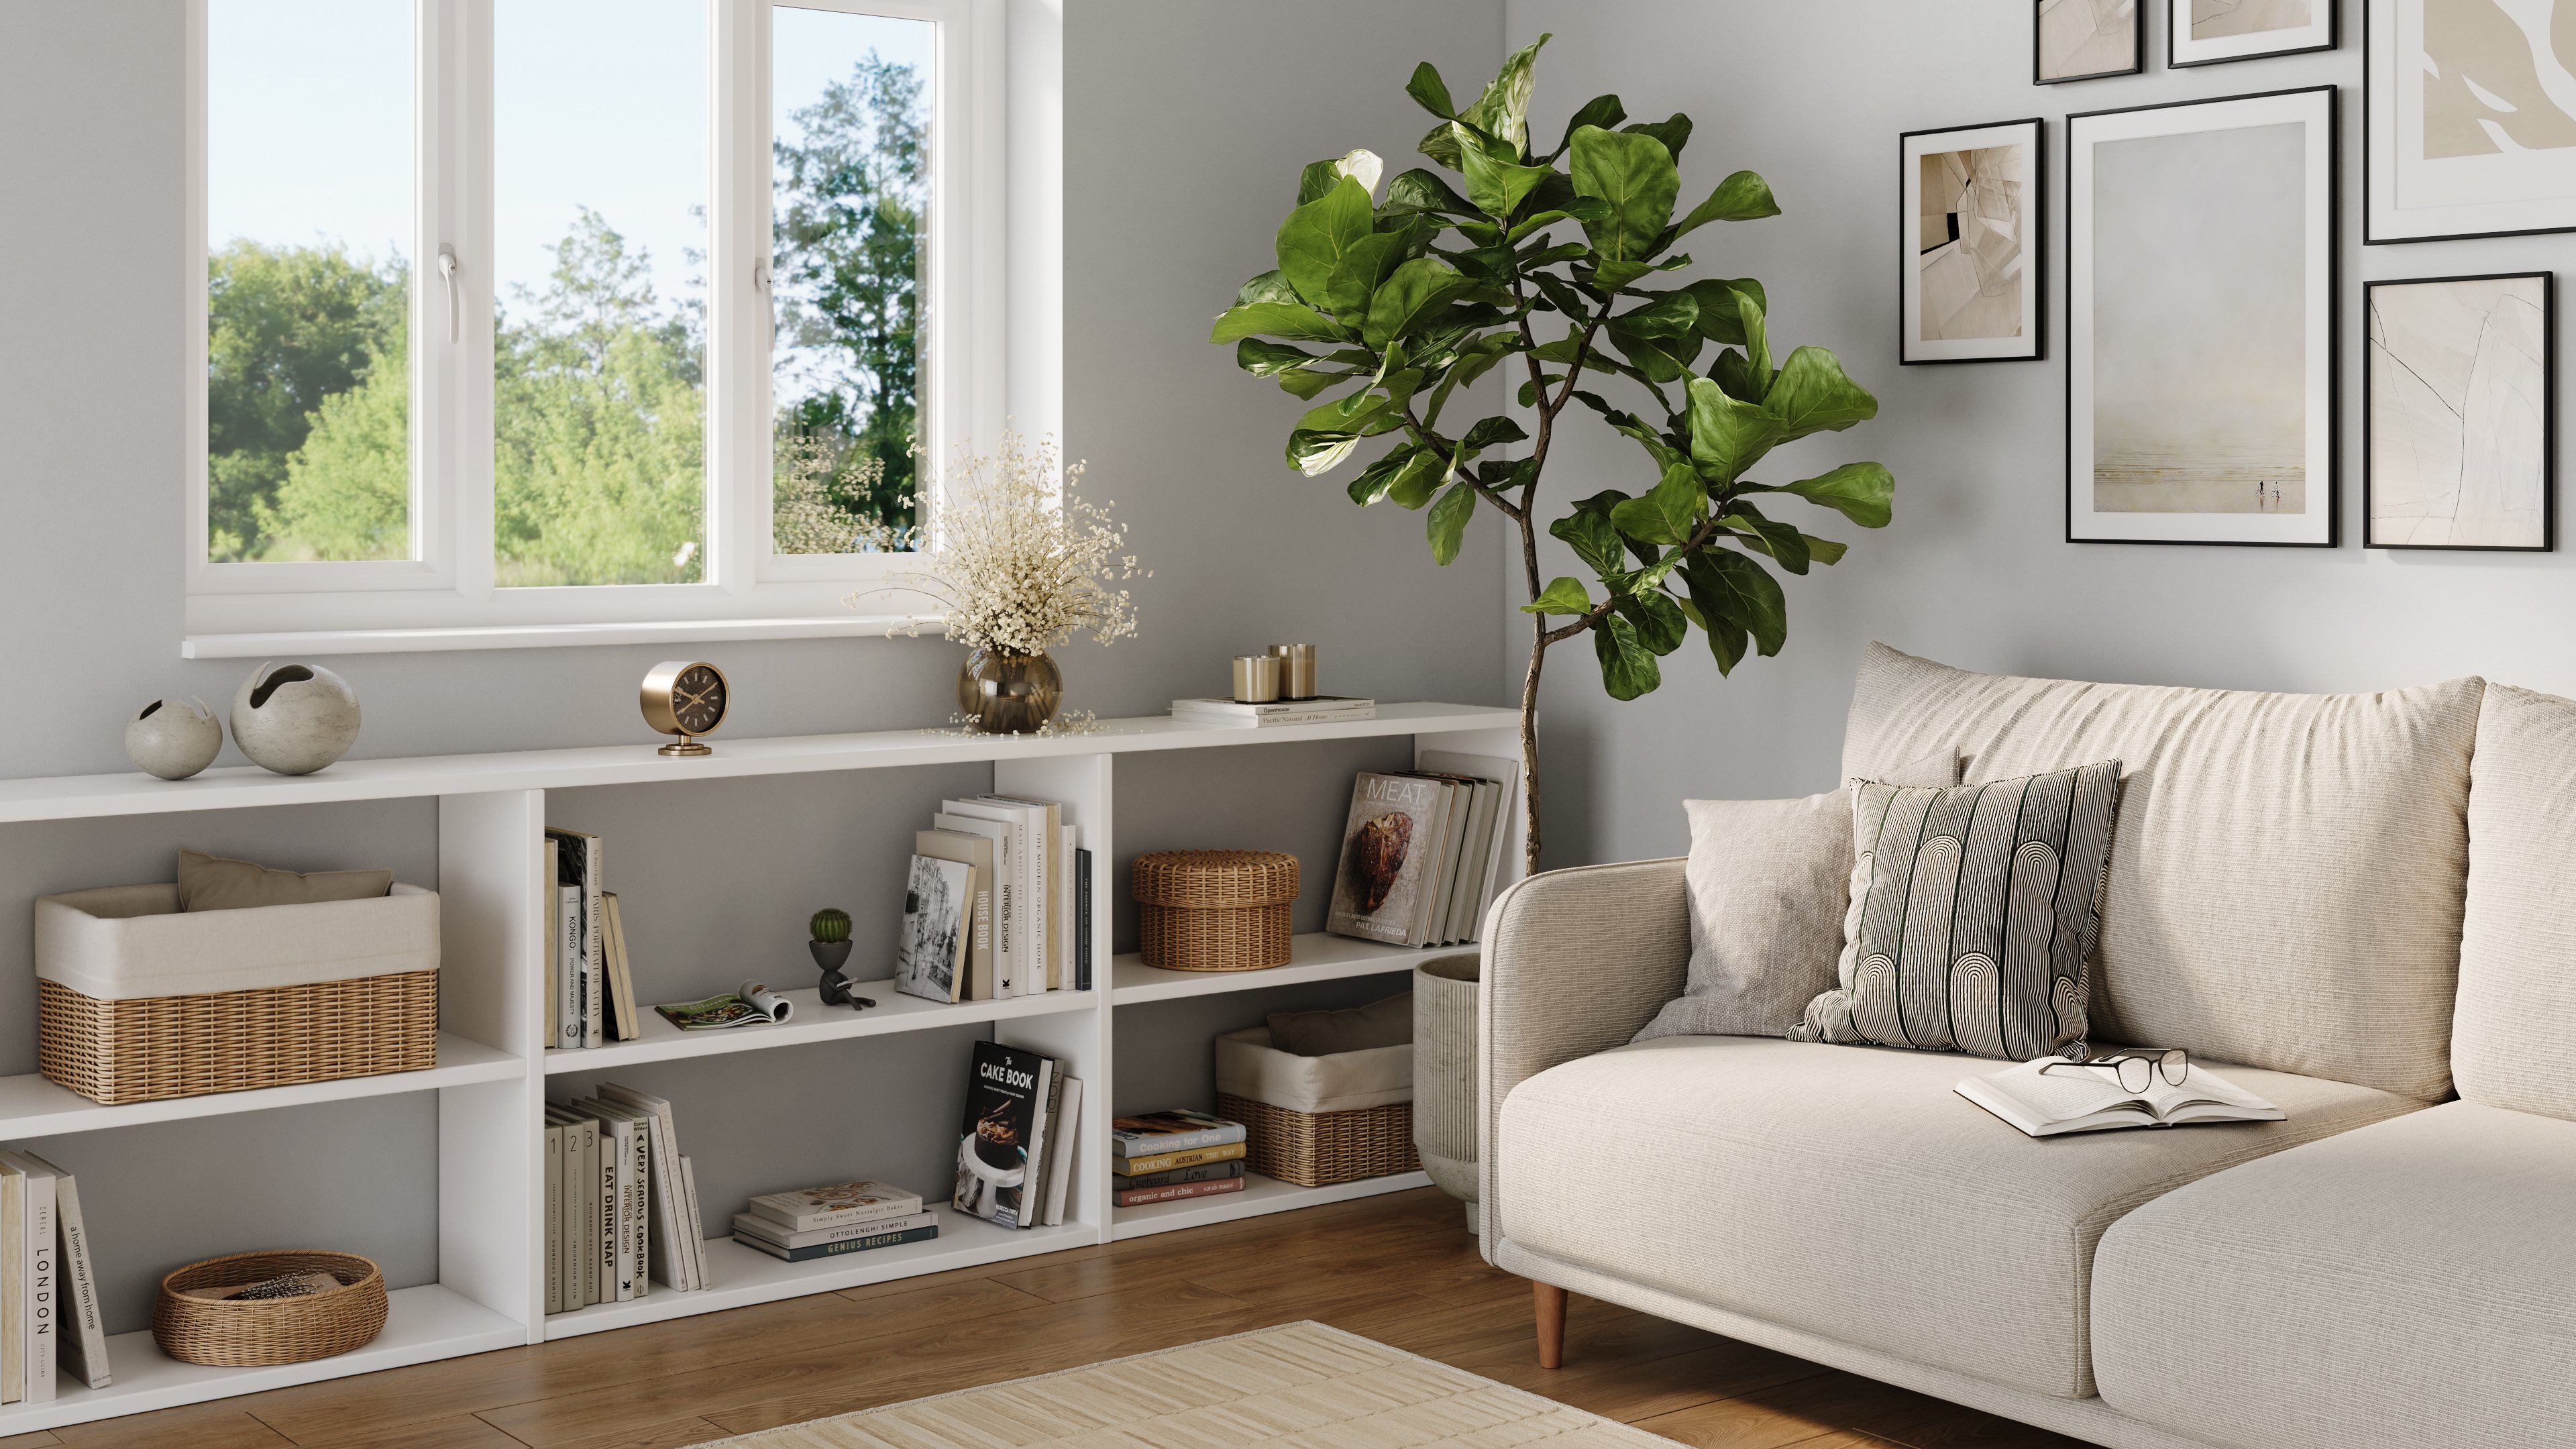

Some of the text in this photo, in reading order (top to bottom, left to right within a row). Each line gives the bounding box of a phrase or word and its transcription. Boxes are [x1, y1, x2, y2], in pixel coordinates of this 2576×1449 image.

[1367, 777, 1426, 805] MEAT
[977, 890, 989, 951] HOUSE BOOK
[1356, 921, 1407, 937] PAT LAFRIEDA
[593, 973, 600, 985] OF
[980, 1062, 1033, 1090] CAKE BOOK
[551, 1138, 555, 1154] 1
[570, 1135, 577, 1152] 2
[586, 1130, 593, 1147] 3
[1139, 1133, 1222, 1152] Cooking for One
[1133, 1158, 1172, 1173] COOKING
[1175, 1153, 1203, 1165] AUSTRIAN
[1205, 1151, 1219, 1160] THE
[1222, 1148, 1235, 1157] WAY
[1183, 1169, 1208, 1181] Love
[1128, 1187, 1194, 1203] organic and chic
[604, 1166, 614, 1267] EAT DRINK NAP
[636, 1134, 645, 1279] A VERY SERIOUS COOKBOOK
[812, 1214, 834, 1223] Simply
[835, 1211, 853, 1220] Sweet
[855, 1206, 885, 1216] Nostalgic
[830, 1220, 908, 1239] OTTOLENGHI SIMPLE
[72, 1232, 82, 1258] home
[827, 1233, 903, 1253] GENIUS RECIPES
[76, 1259, 87, 1282] away
[37, 1248, 49, 1335] LONDON
[81, 1282, 91, 1304] from
[85, 1303, 95, 1330] home
